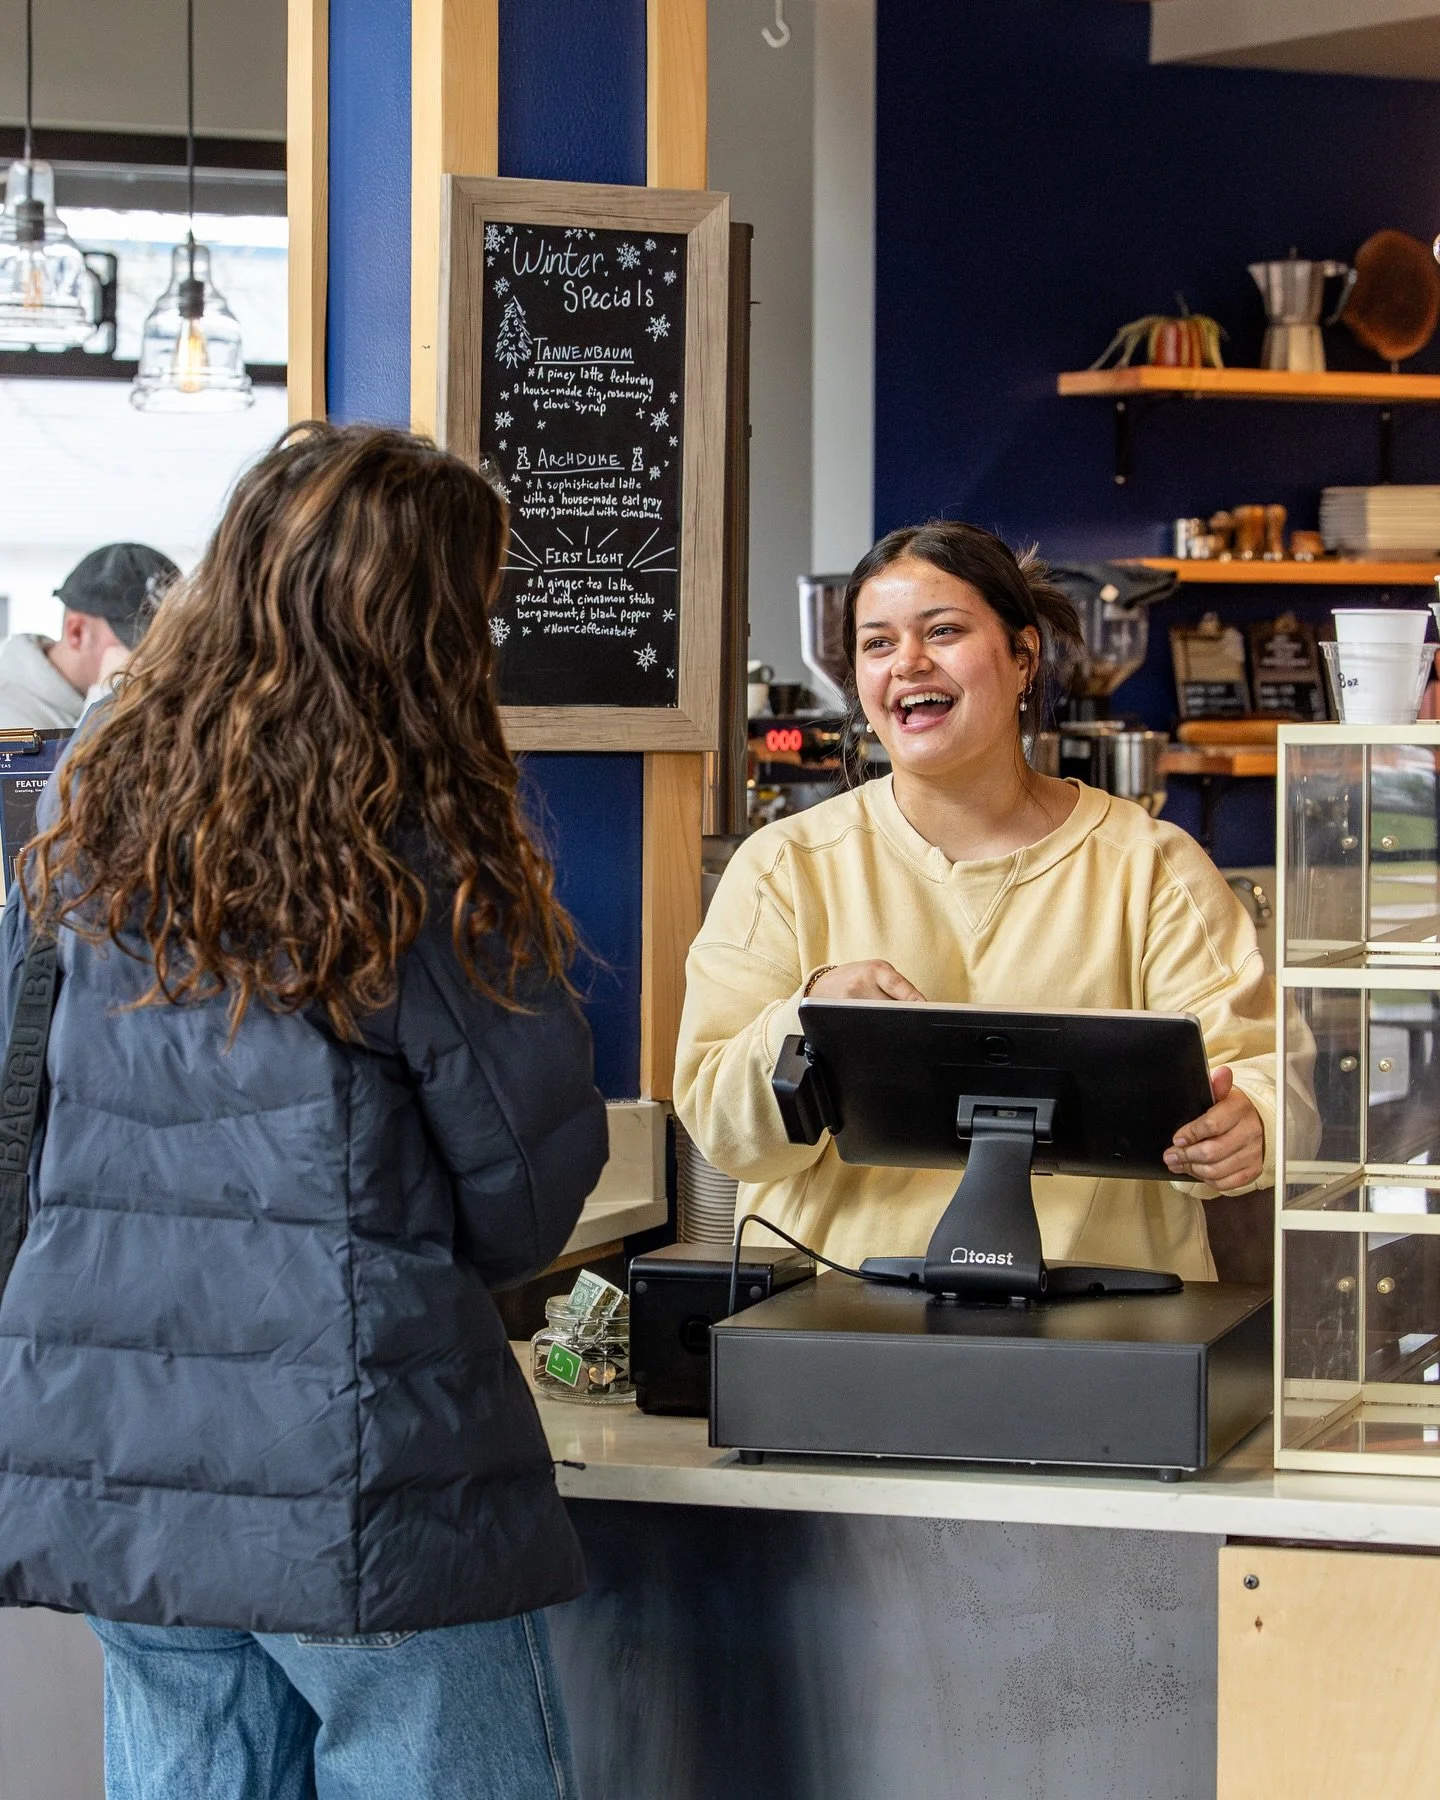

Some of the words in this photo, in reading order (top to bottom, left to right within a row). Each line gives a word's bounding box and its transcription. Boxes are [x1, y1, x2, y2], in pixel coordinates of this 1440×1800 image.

[512, 236, 604, 278] Winter
[563, 280, 654, 313] Specials
[533, 337, 633, 361] TANNENBAUM
[537, 365, 544, 380] A
[547, 368, 576, 387] piney
[580, 366, 604, 382] latte
[609, 368, 655, 394] featuring
[513, 383, 520, 394] a
[522, 381, 583, 398] house-made
[607, 389, 652, 404] rosemary,
[542, 397, 571, 410] clove
[573, 400, 607, 417] syrup
[537, 448, 621, 470] ARCHDUKE
[536, 478, 543, 490] A
[546, 477, 616, 494] sophisticated
[619, 477, 642, 490] latte
[523, 491, 547, 505] with
[548, 494, 555, 504] a
[561, 492, 618, 506] house-made
[621, 493, 640, 506] earl
[642, 497, 662, 512] gray
[550, 506, 595, 520] garnished
[596, 506, 618, 517] with
[620, 508, 663, 520] cinnamon.
[546, 548, 583, 564] FIRST
[586, 548, 624, 564] LIGHT
[537, 575, 545, 589] A
[547, 577, 584, 597] ginger
[586, 576, 603, 590] tea
[608, 576, 635, 592] latte
[515, 592, 548, 606] spiced
[552, 591, 574, 605] with
[577, 594, 625, 606] cinnamon
[629, 592, 655, 605] sticks
[590, 606, 617, 620] black
[620, 609, 651, 624] pepper
[15, 780, 48, 788] FEATUR
[0, 1025, 43, 1172] BAGGU
[968, 1249, 1014, 1266] toast
